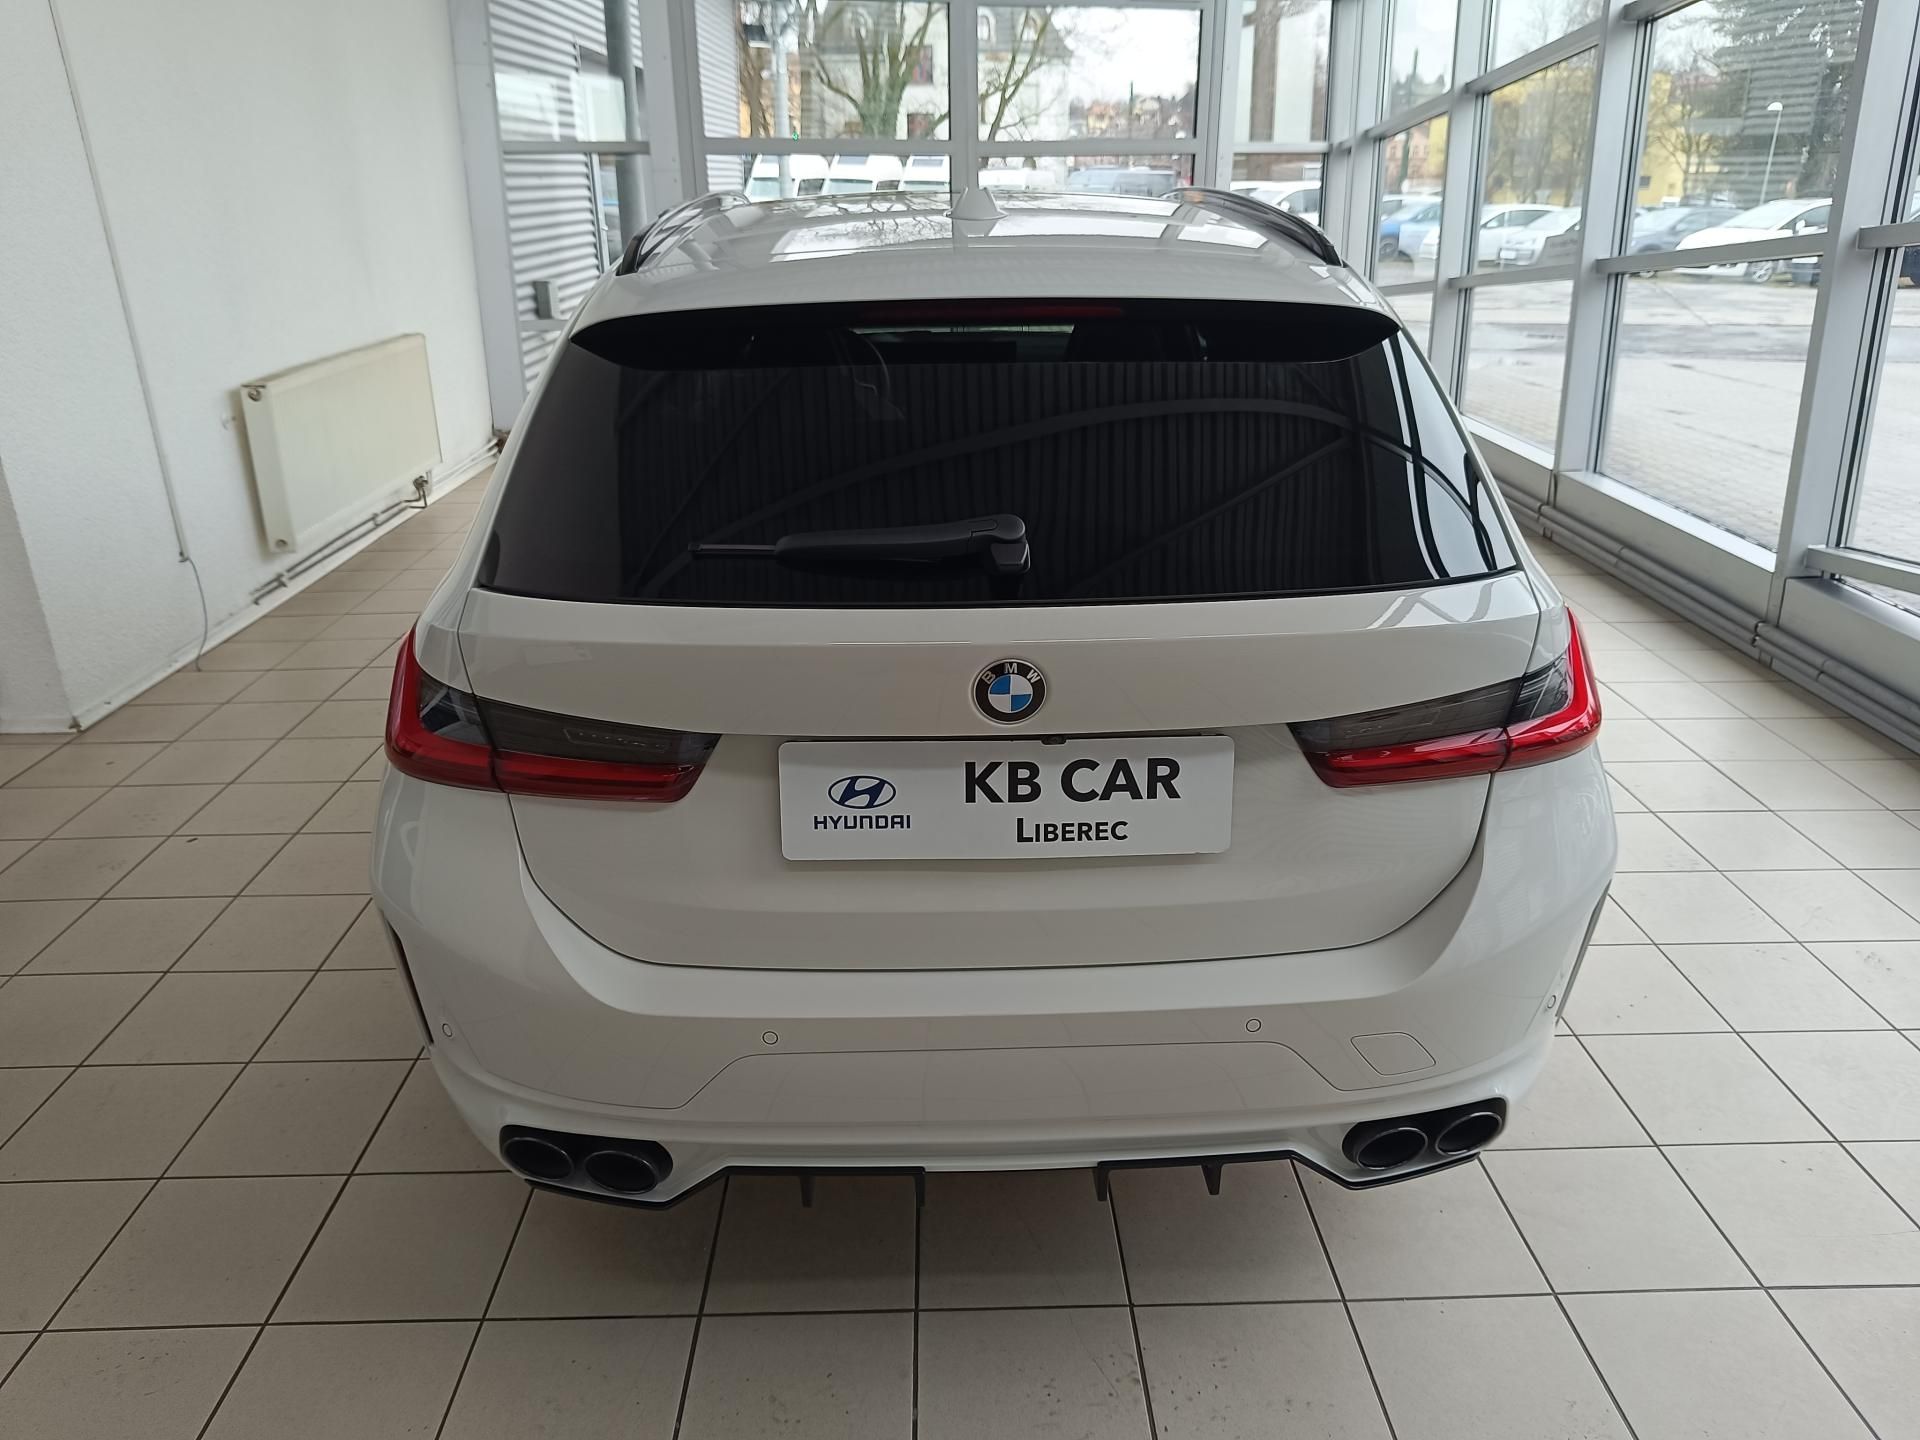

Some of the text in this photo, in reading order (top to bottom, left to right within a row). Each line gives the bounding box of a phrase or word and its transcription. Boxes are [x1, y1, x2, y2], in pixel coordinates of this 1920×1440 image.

[981, 662, 1041, 685] BMW
[965, 757, 1182, 804] KB CAR
[813, 814, 912, 830] HYUNDAI
[1016, 817, 1129, 843] LIBEREC
